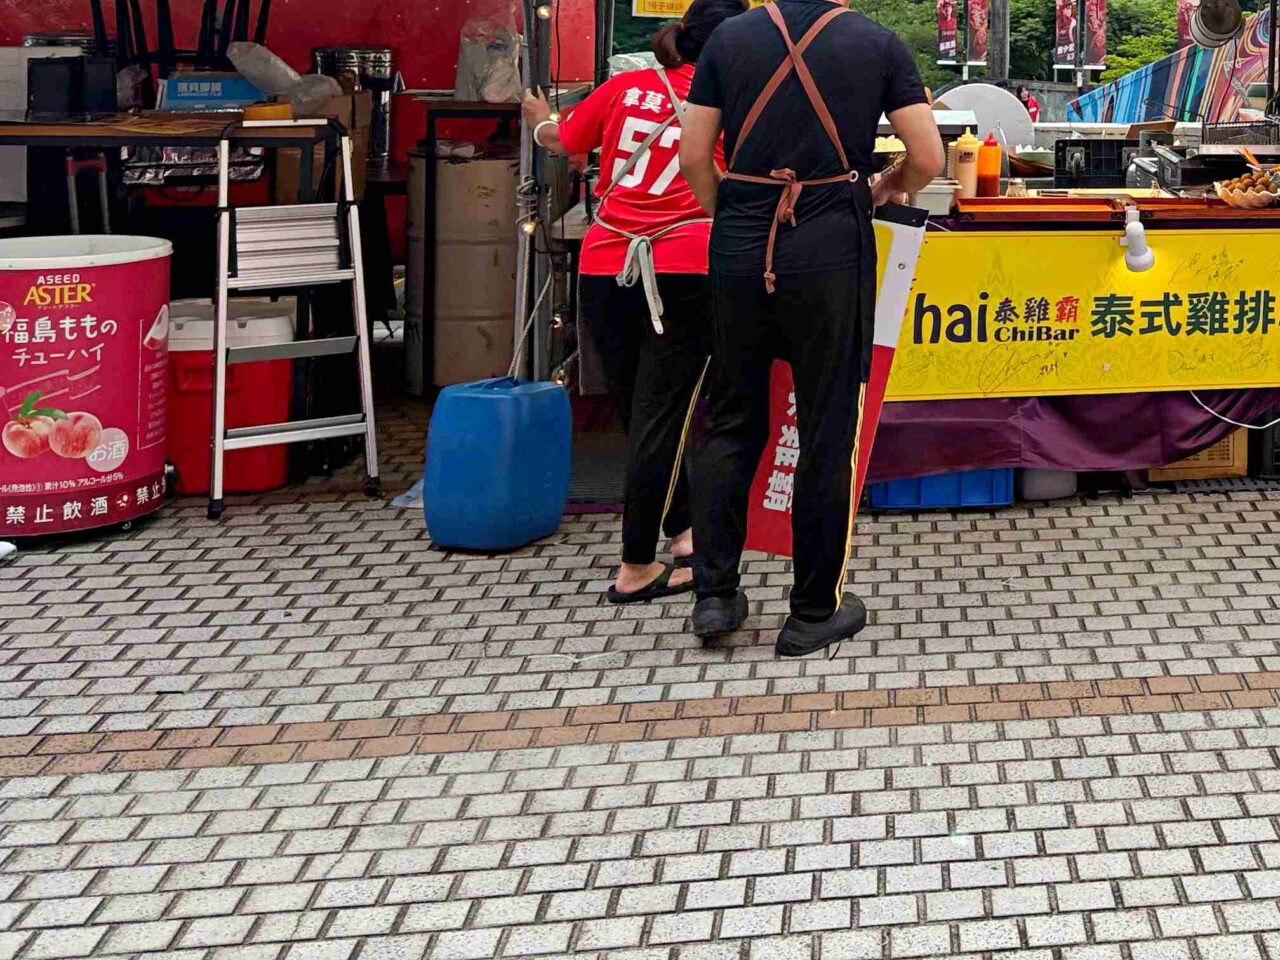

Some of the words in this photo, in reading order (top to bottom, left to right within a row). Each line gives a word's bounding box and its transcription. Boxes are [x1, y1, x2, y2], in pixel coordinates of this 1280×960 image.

[611, 116, 682, 196] 57
[37, 274, 80, 285] ASEED
[23, 283, 93, 306] ASTER
[903, 291, 988, 344] hai
[993, 297, 1079, 324] 泰雞霸
[2, 315, 118, 344] 福島ももの
[994, 324, 1080, 343] ChiBar
[12, 343, 105, 367] チューハイ
[89, 440, 126, 462] お酒
[6, 496, 108, 525] 禁止飲酒
